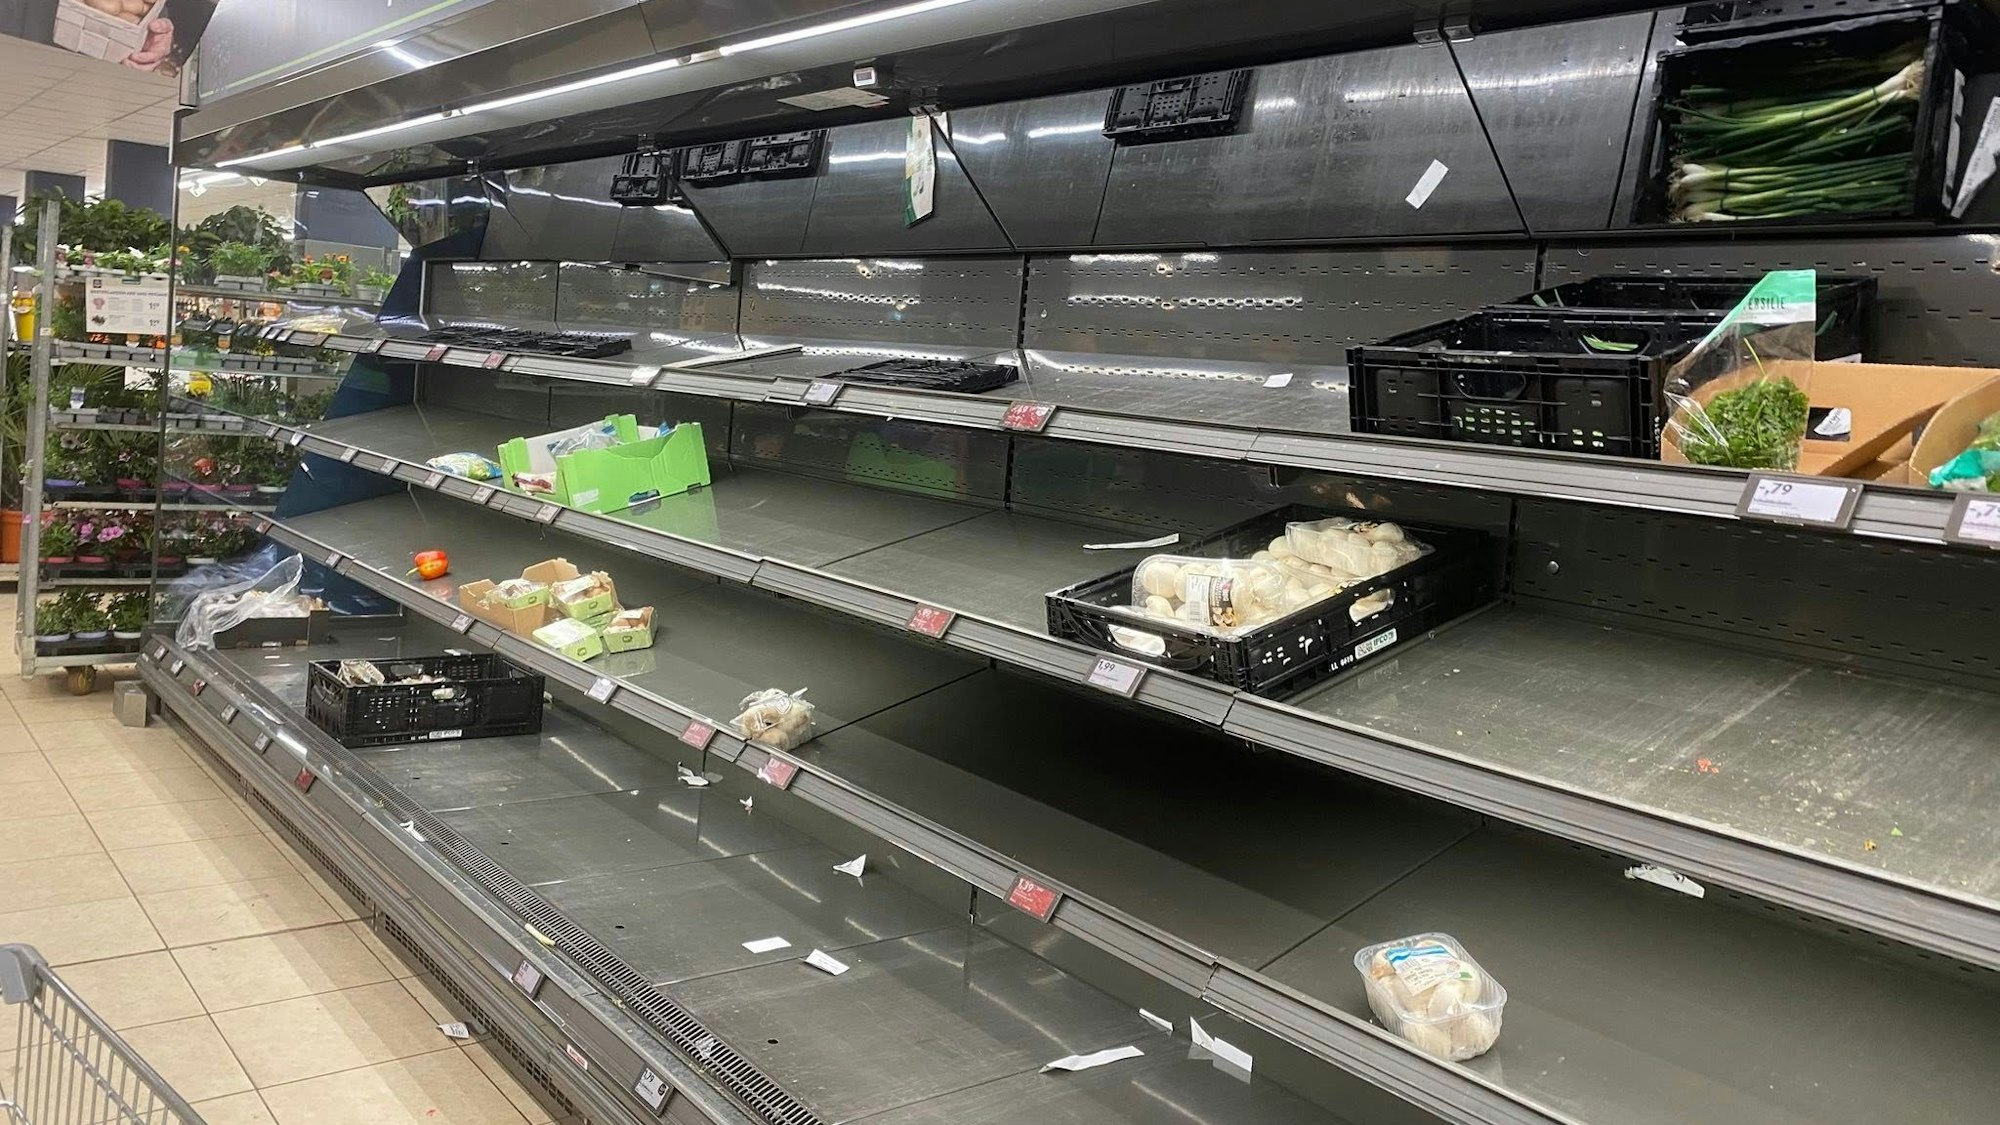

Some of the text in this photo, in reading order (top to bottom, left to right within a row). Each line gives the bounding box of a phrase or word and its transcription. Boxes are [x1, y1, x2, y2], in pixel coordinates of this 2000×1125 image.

[1759, 482, 1793, 495] -,79
[1373, 633, 1388, 647] IFCO
[1098, 660, 1116, 671] 1,99
